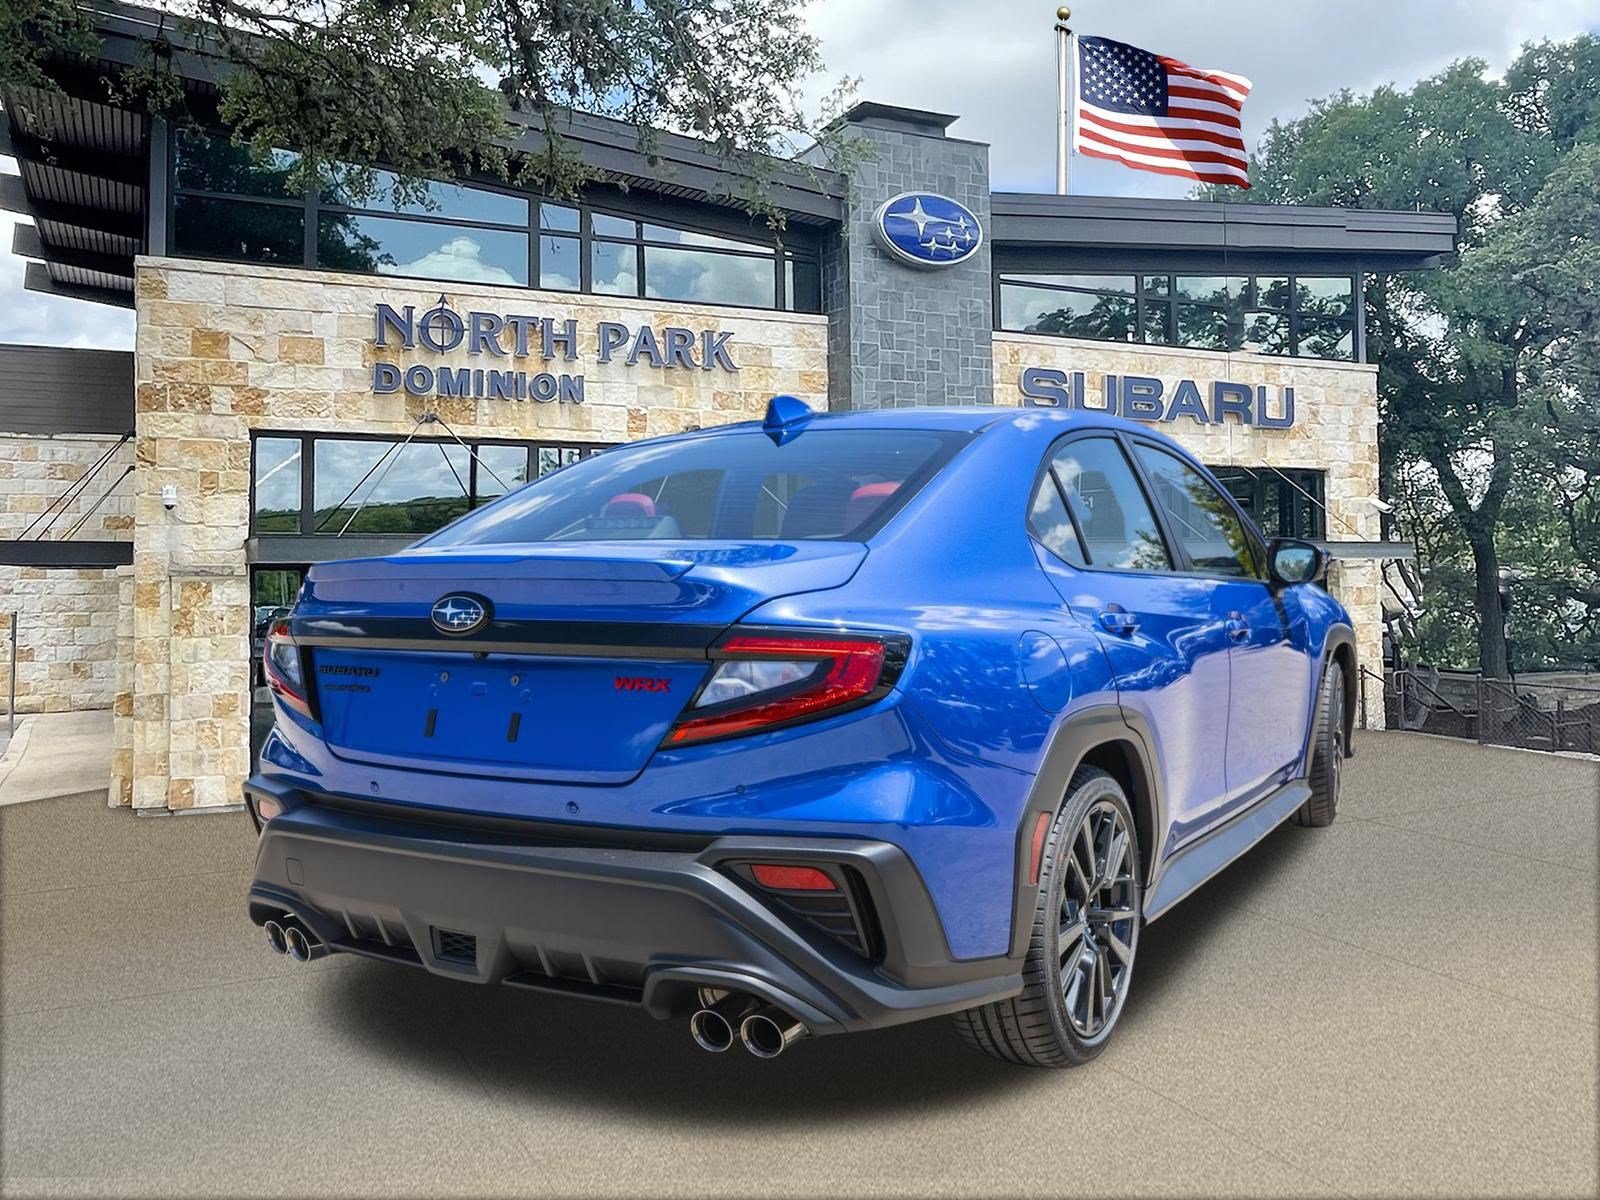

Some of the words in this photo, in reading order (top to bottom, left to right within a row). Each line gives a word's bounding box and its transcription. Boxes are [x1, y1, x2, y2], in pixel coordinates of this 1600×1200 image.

[374, 300, 579, 361] NORTH
[597, 322, 741, 373] PARK
[372, 363, 585, 404] DOMINION
[1018, 366, 1295, 430] SUBARU
[614, 676, 671, 693] WRX
